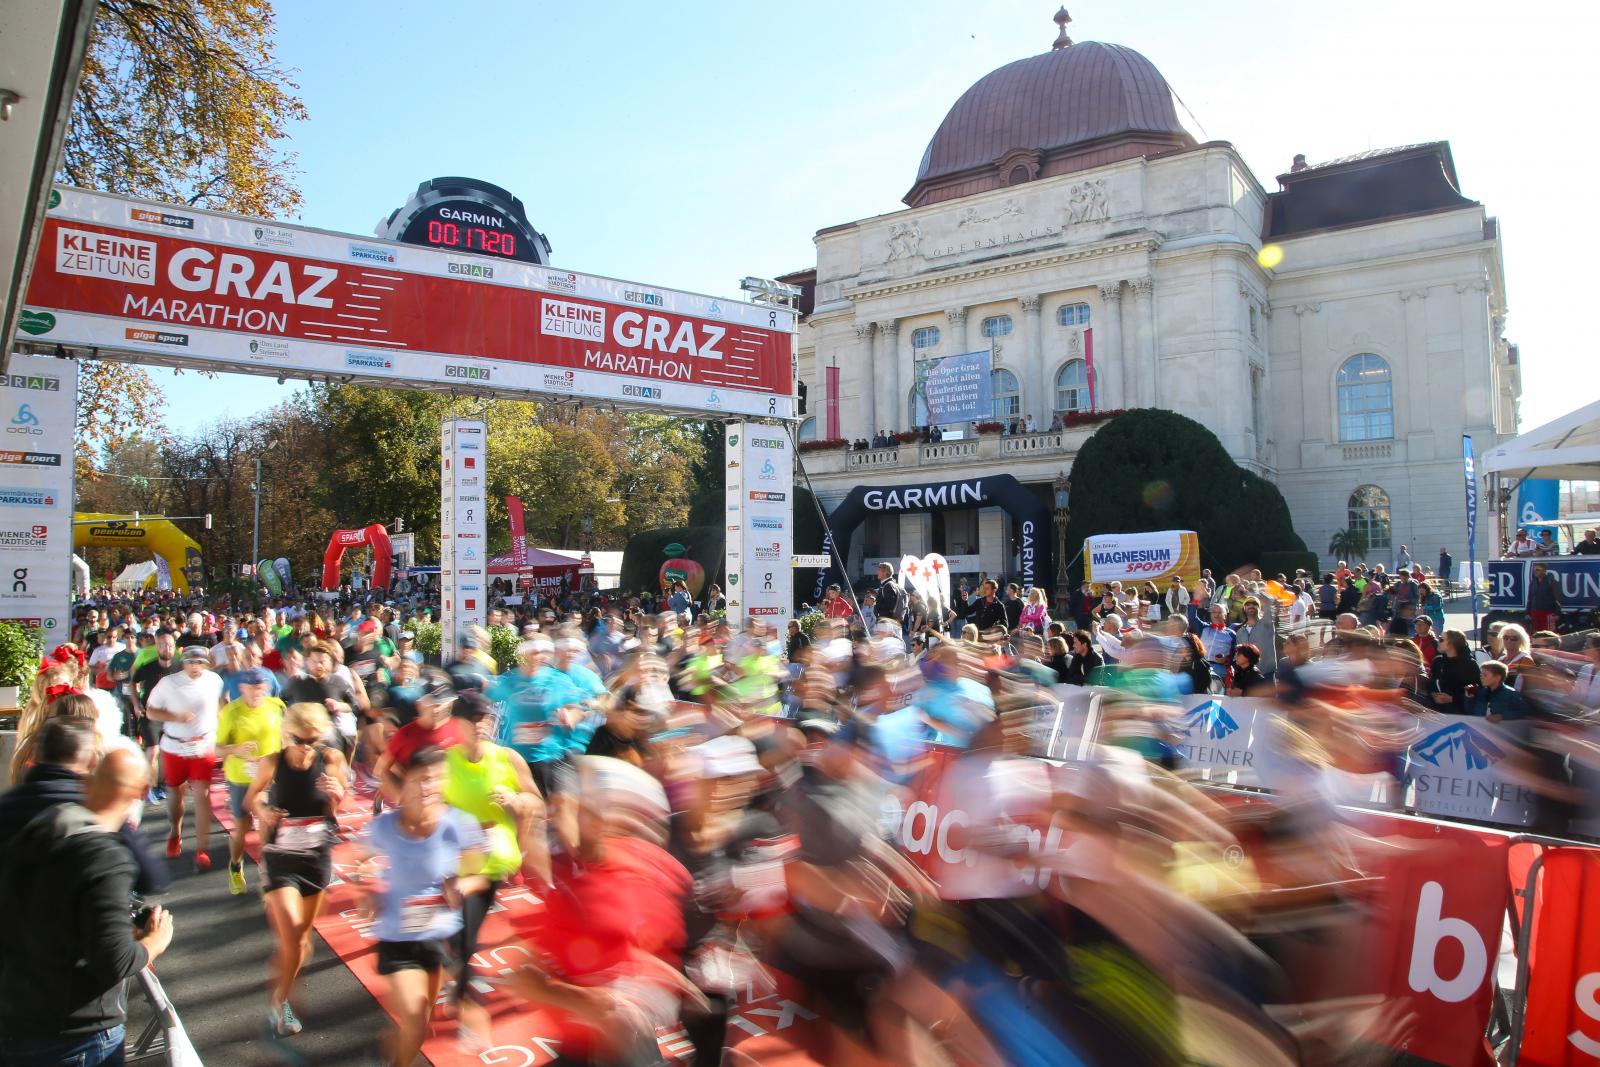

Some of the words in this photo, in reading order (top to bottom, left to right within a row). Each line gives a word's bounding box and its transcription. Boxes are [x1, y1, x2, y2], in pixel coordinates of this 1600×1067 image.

[164, 215, 190, 226] sport
[439, 207, 503, 227] GARMIN
[63, 234, 151, 261] KLEINE
[933, 226, 1053, 257] OPERNHAUS
[352, 251, 388, 262] SPARKASSE
[62, 252, 151, 279] ZEITUNG
[449, 263, 493, 278] GRAZ
[167, 248, 338, 309] GRAZ
[624, 291, 663, 306] GRAZ
[122, 294, 288, 333] MARATHON
[546, 303, 602, 324] KLEINE
[545, 318, 602, 338] ZEITUNG
[133, 331, 155, 341] giga
[158, 334, 185, 343] sport
[612, 311, 727, 360] GRAZ
[348, 358, 384, 368] SPARKASSE
[584, 350, 692, 380] MARATHON
[926, 368, 939, 377] Die
[940, 366, 959, 376] Oper
[961, 363, 980, 371] Graz
[446, 366, 489, 380] GRAZ
[544, 373, 564, 381] WIENER
[927, 376, 959, 386] wünscht
[960, 373, 980, 381] allen
[623, 385, 662, 399] GRAZ
[929, 383, 978, 395] Läuferinnen
[929, 396, 945, 405] und
[946, 392, 978, 403] Läufern
[962, 401, 976, 410] toi!
[752, 438, 784, 449] GRAZ
[25, 455, 56, 464] sport
[863, 480, 982, 510] GARMIN
[800, 555, 829, 564] frutura
[1093, 549, 1170, 565] MAGNESIUM
[1126, 561, 1170, 573] SPORT
